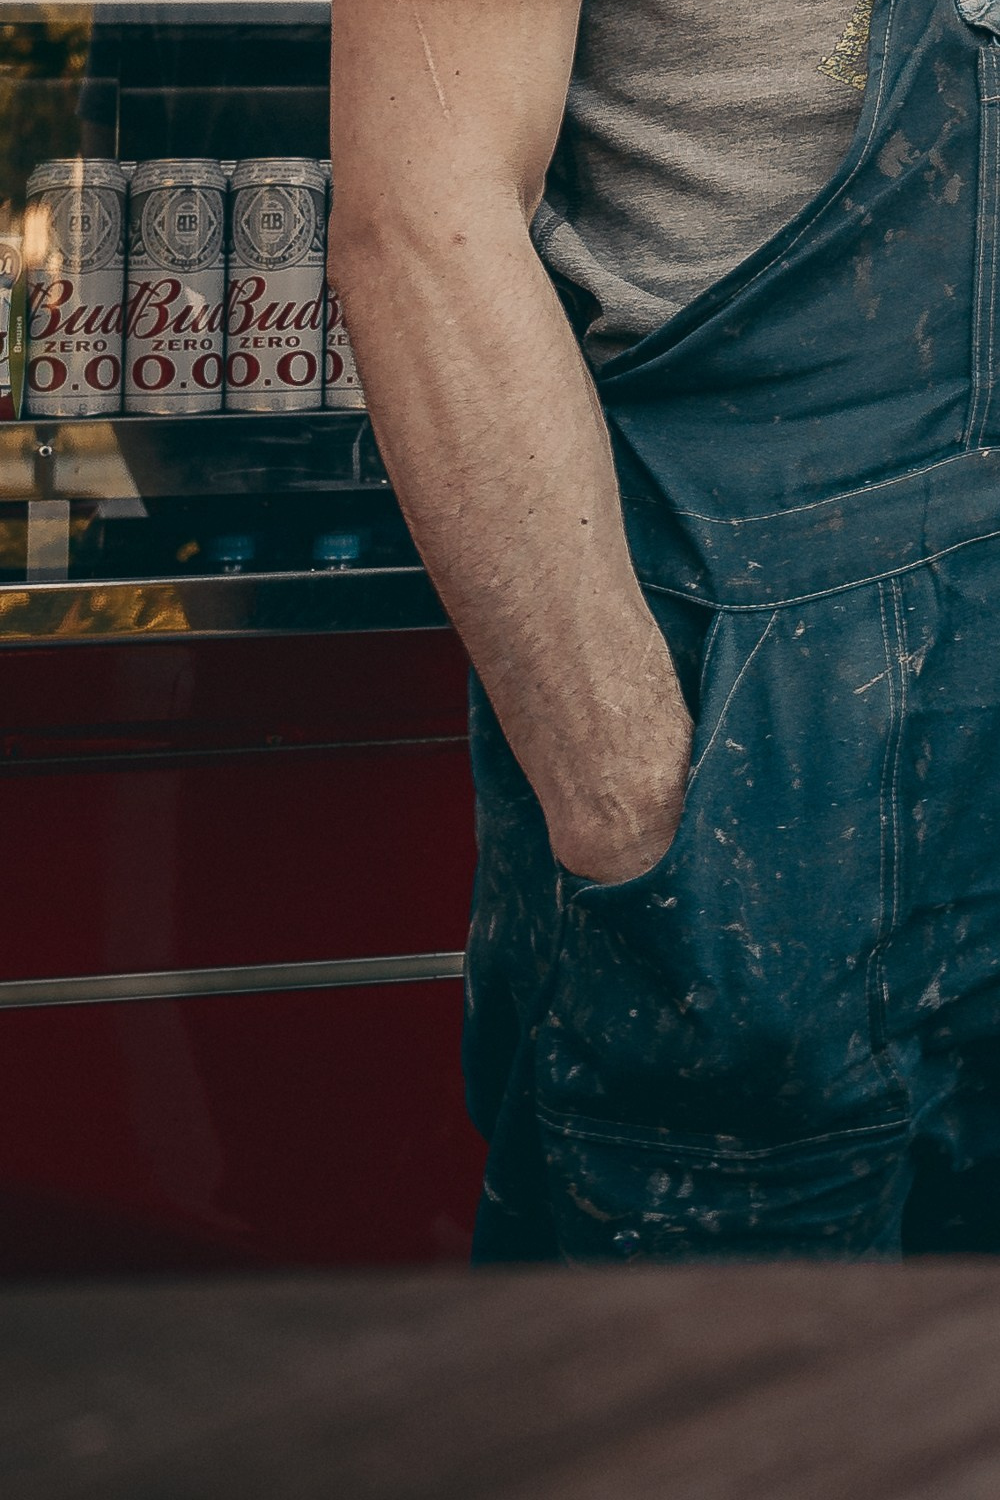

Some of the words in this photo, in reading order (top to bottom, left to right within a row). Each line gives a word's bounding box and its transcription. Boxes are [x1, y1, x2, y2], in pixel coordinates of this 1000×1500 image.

[30, 279, 125, 341] Bud
[129, 277, 227, 339] Bud
[226, 275, 325, 337] Bud
[44, 339, 108, 353] ZERO
[152, 338, 214, 352] ZERO
[239, 336, 301, 349] ZERO
[328, 334, 351, 347] ZE
[28, 354, 121, 393] 0.0
[131, 353, 226, 392] 0.0
[226, 351, 318, 387] 0.0
